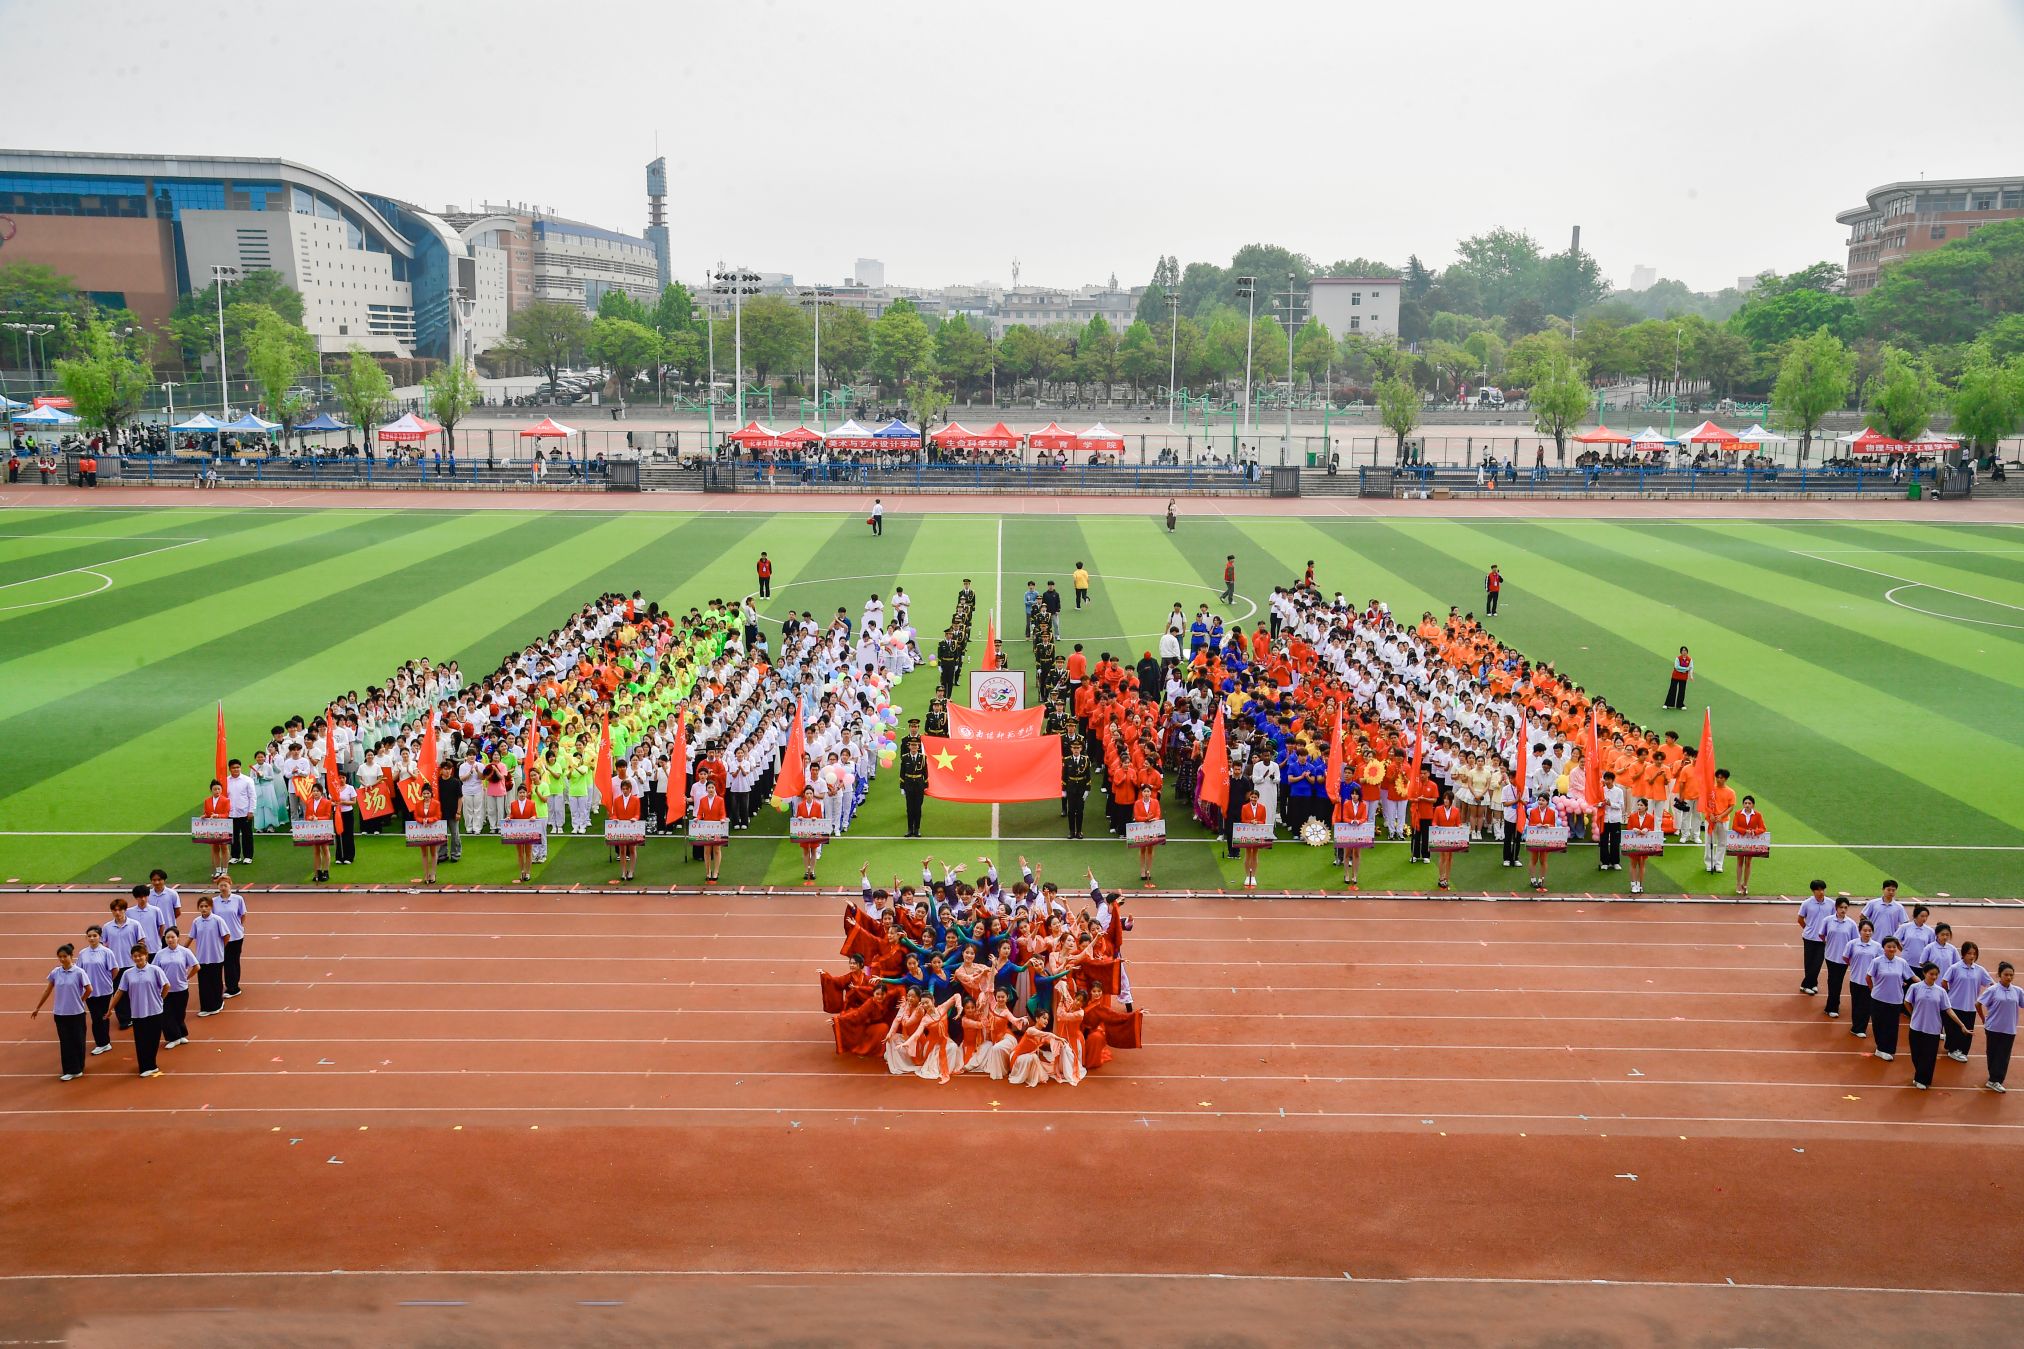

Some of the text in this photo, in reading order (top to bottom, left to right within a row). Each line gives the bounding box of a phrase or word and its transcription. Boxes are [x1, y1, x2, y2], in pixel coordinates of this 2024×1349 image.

[828, 439, 920, 448] 美术与艺术设计学院
[946, 439, 1009, 447] 生命科学学院
[1033, 439, 1117, 449] 体育学院
[1865, 443, 1954, 452] 物理与电子工程学院
[364, 787, 386, 817] 场
